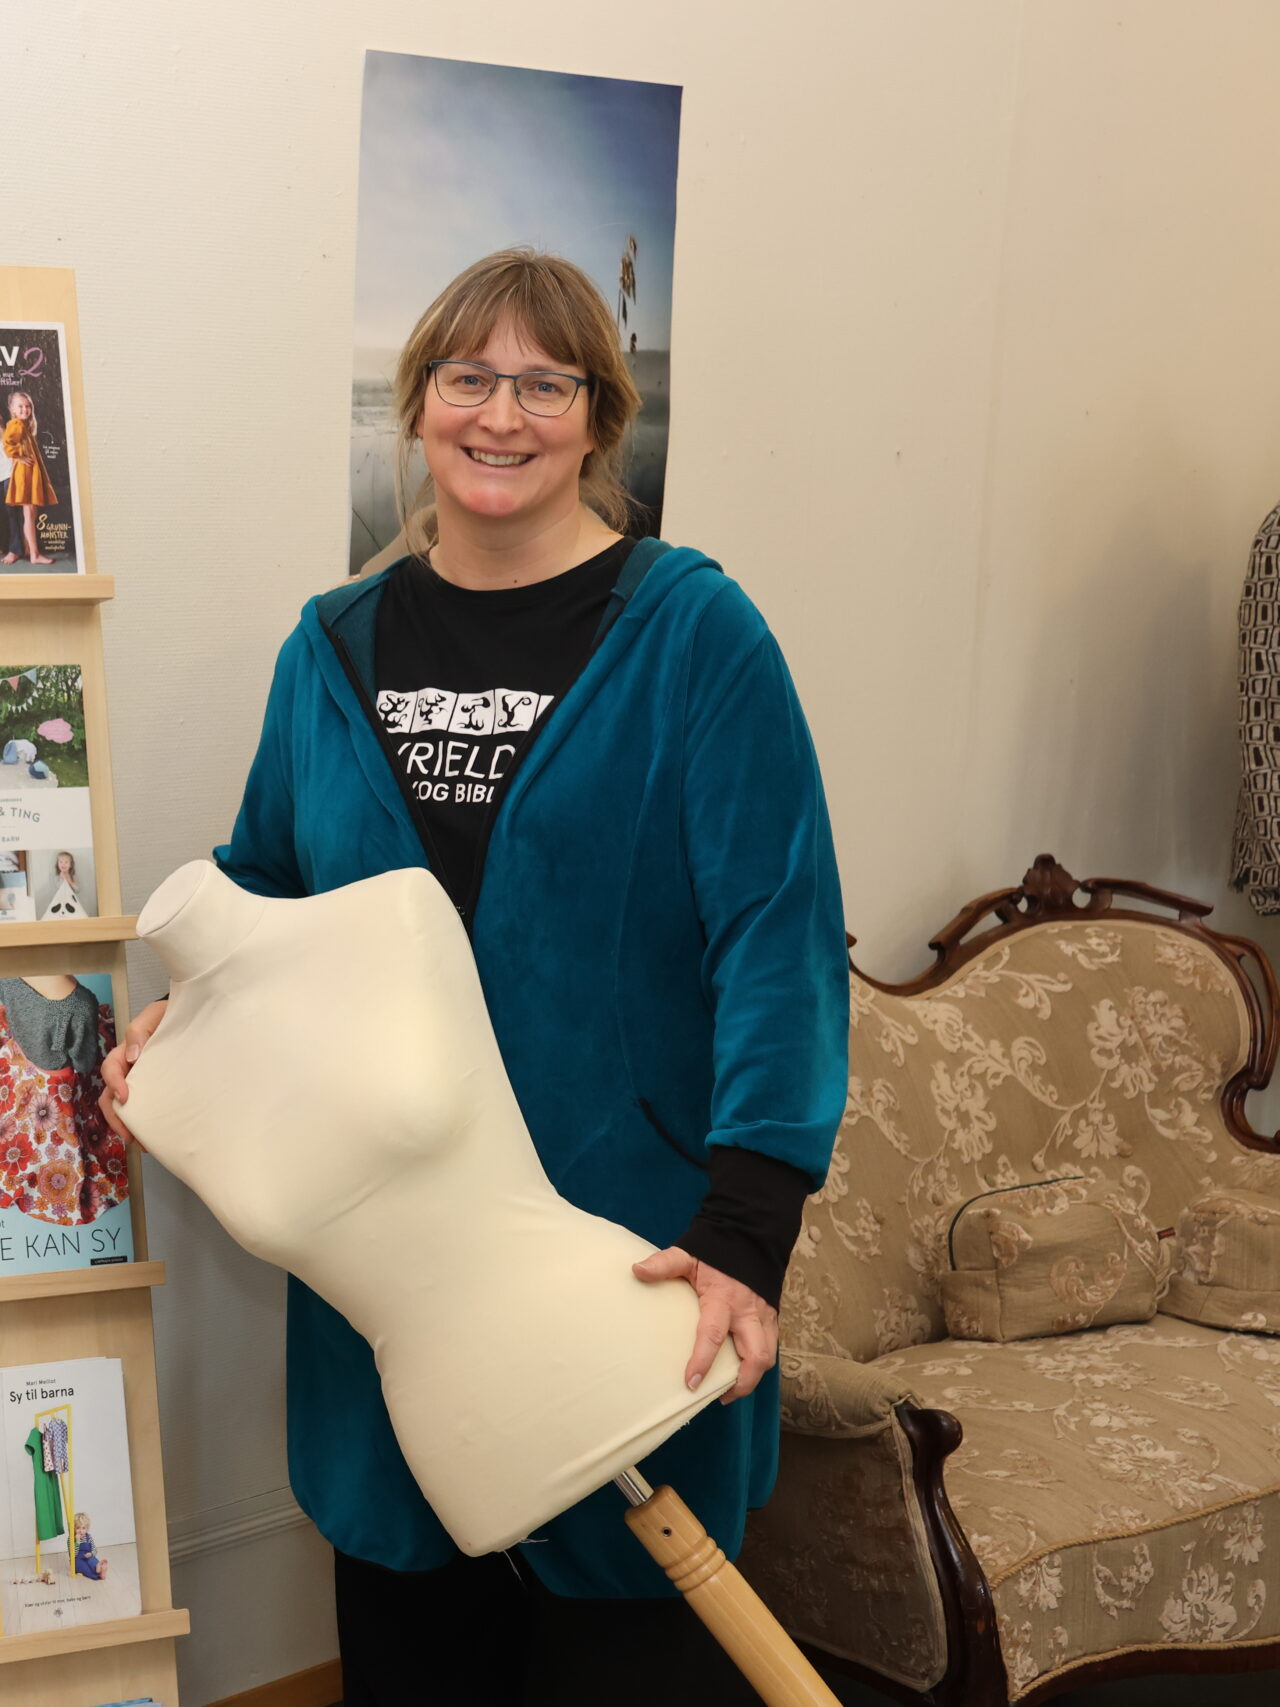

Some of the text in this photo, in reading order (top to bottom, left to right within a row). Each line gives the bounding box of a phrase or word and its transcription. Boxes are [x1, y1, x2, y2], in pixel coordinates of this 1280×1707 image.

[18, 347, 44, 377] 2
[36, 514, 48, 531] 8
[10, 807, 41, 823] TING
[25, 1231, 80, 1259] KAN
[90, 1227, 122, 1253] SY
[9, 1386, 74, 1404] Sy til barna
